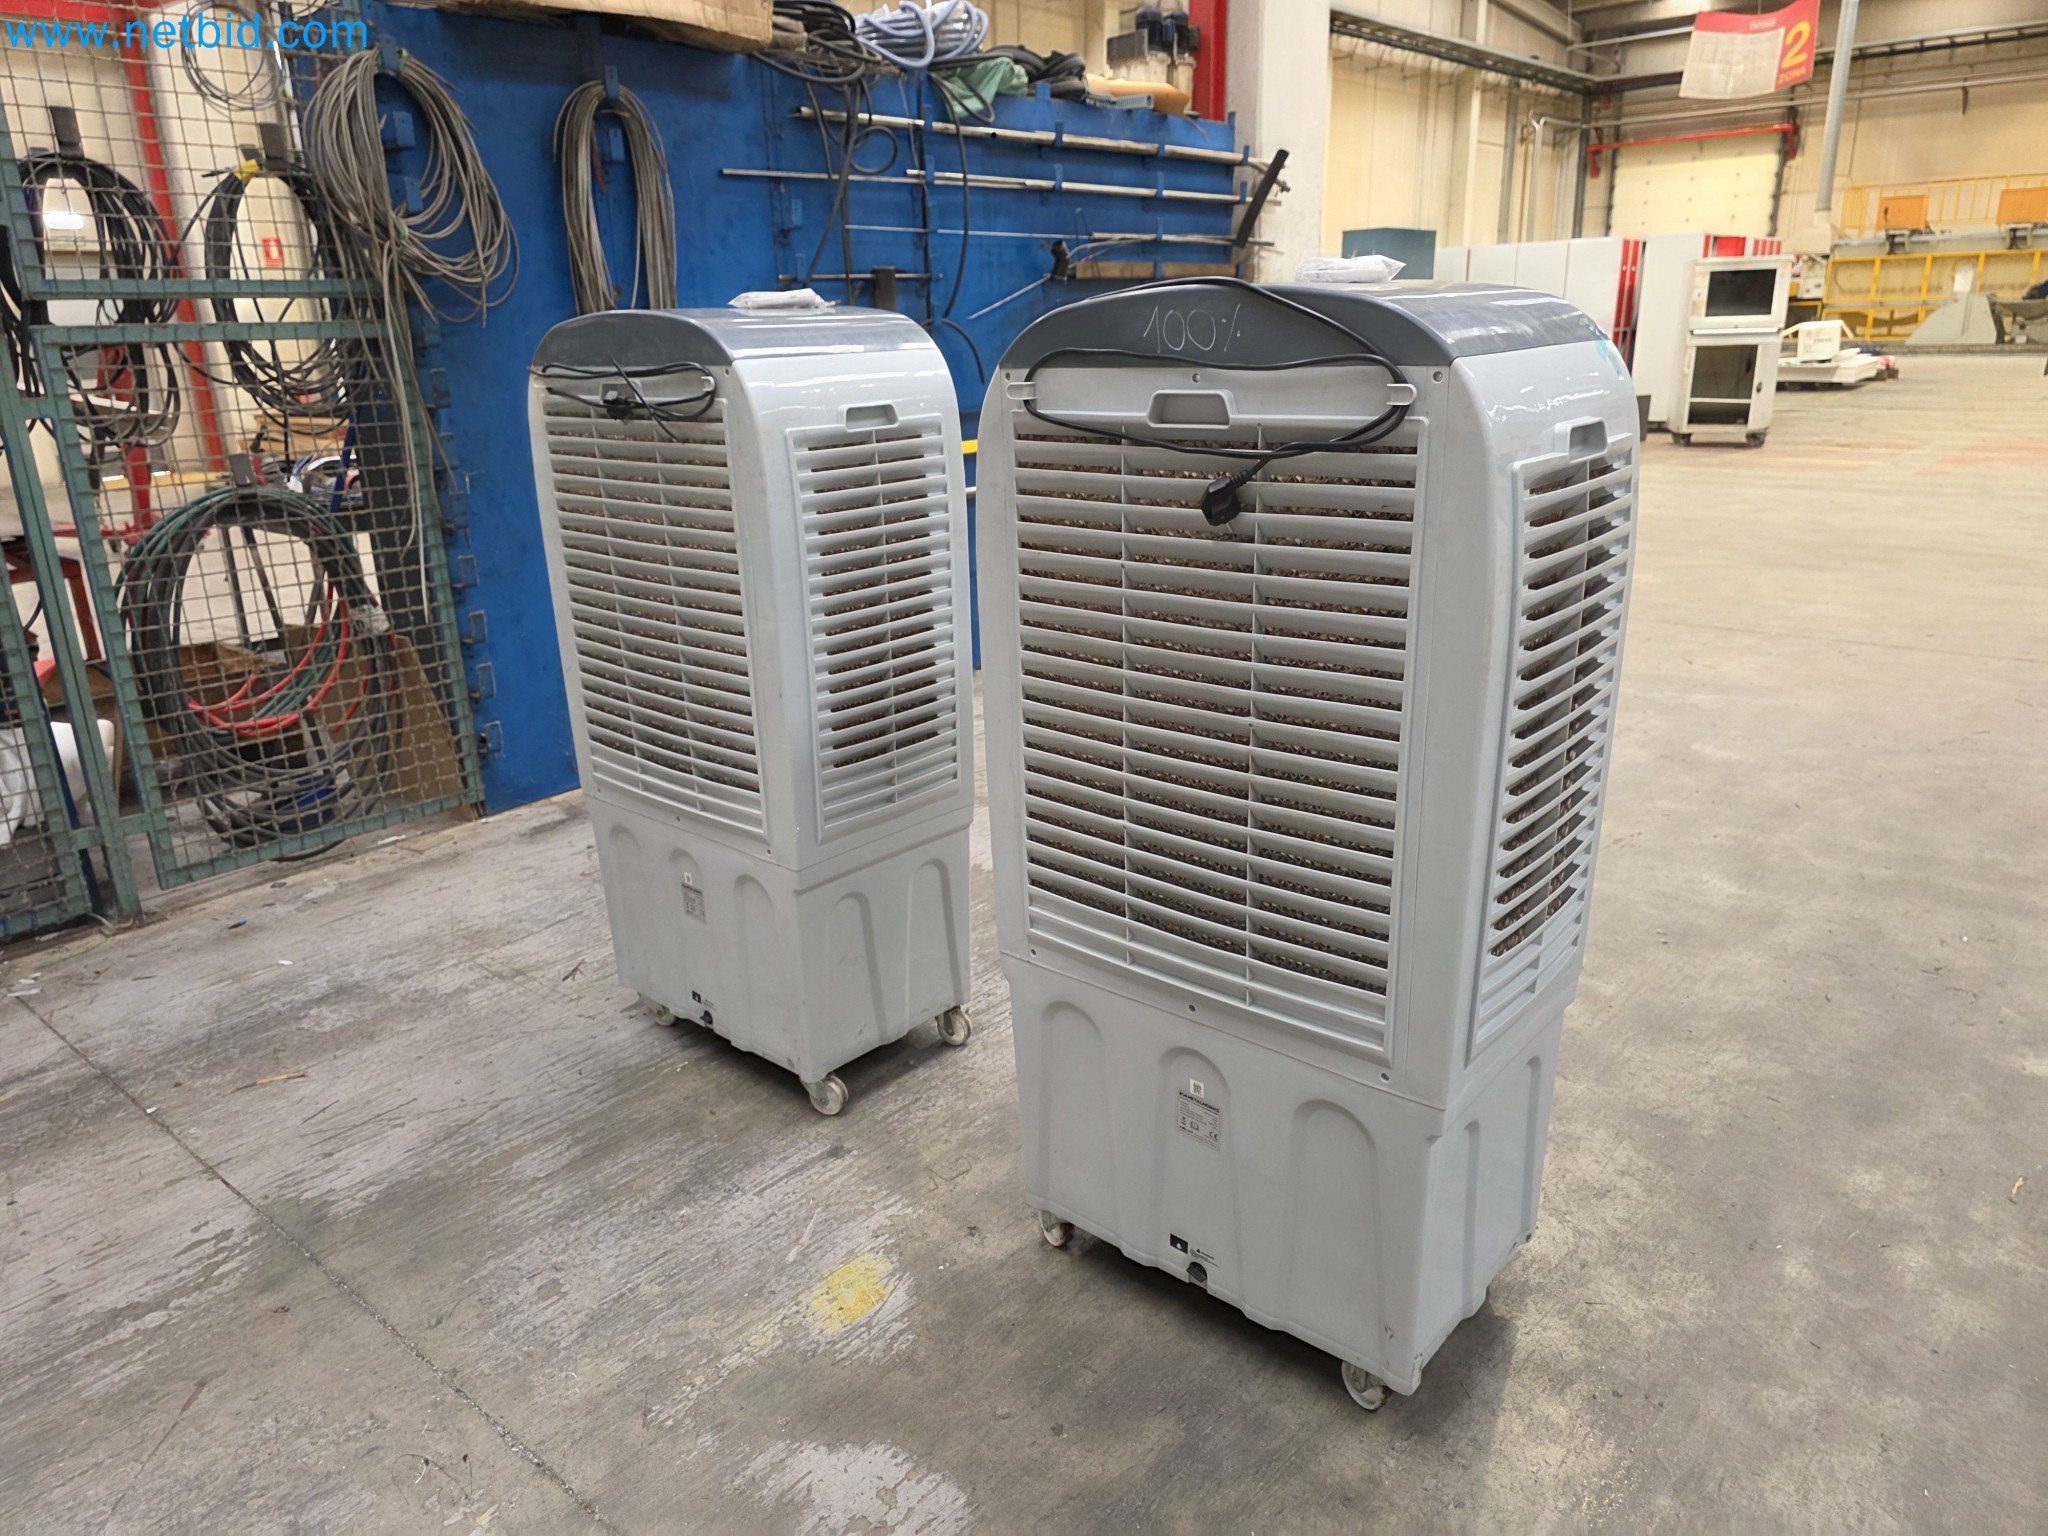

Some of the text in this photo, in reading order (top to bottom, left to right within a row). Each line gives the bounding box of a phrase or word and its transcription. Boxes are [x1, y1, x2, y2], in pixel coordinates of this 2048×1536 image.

[1781, 21, 1811, 70] 2
[1777, 66, 1807, 84] ZONA
[1143, 303, 1241, 353] 100%
